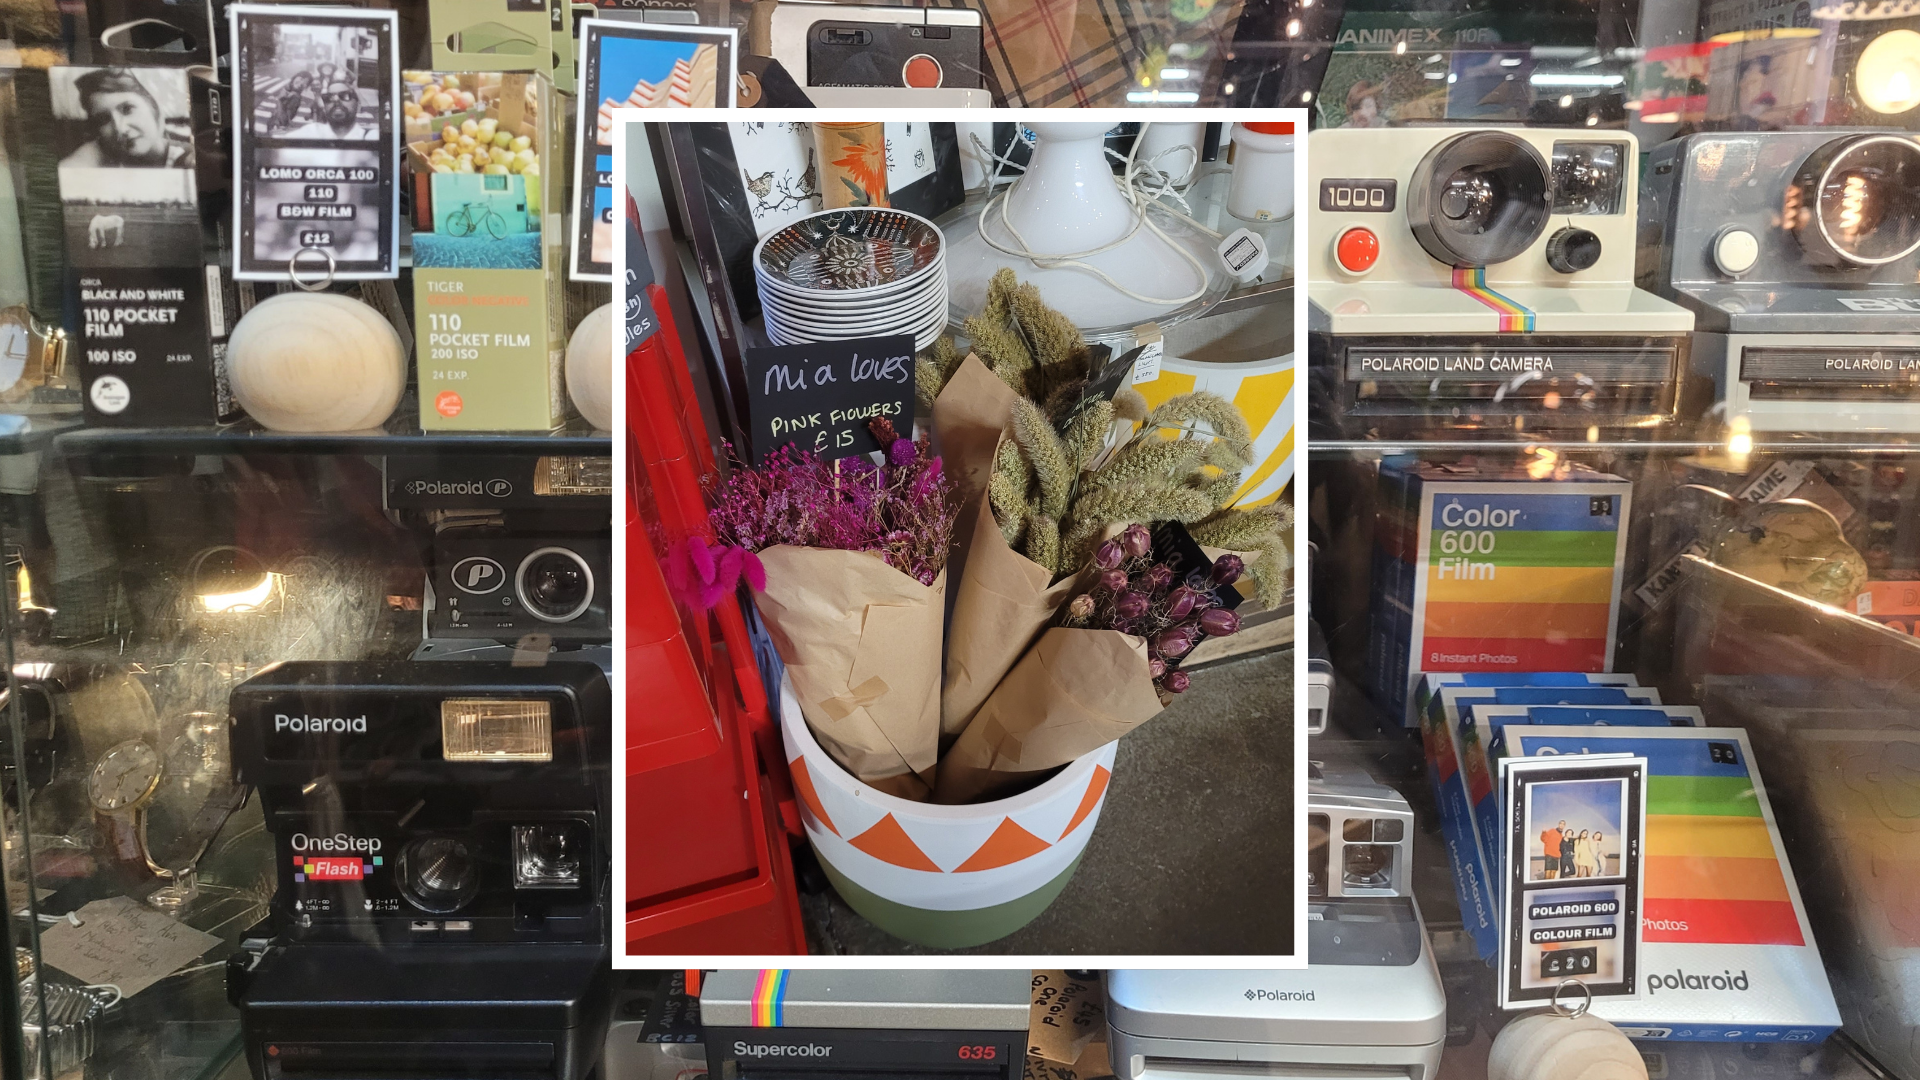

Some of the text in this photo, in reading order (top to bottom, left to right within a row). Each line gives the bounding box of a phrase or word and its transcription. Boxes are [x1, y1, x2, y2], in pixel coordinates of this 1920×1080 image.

[260, 167, 374, 180] LOMO ORCA 100
[308, 188, 334, 199] 110
[1329, 188, 1384, 206] 1000
[281, 206, 352, 218] B&W FILM
[304, 233, 330, 244] £12
[80, 279, 102, 287] ORCA
[427, 281, 464, 292] TIGER
[81, 290, 185, 300] BLACK AND WHITE
[84, 309, 178, 323] 110 POCKET
[429, 314, 462, 331] 110
[85, 323, 124, 337] FILM
[430, 334, 530, 347] POCKET FILM
[87, 351, 109, 363] 100
[112, 351, 137, 363] ISO
[431, 349, 478, 359] 200 ISO
[1362, 357, 1554, 372] POLAROID LAND CAMERA
[1825, 359, 1893, 370] POLAROID
[432, 371, 469, 380] 24 EXP.
[764, 353, 911, 395] Mia loves
[771, 412, 821, 437] PINK
[814, 430, 854, 453] £ 15
[415, 481, 483, 495] Polaroid
[1442, 503, 1521, 527] Color
[1440, 530, 1495, 554] 600
[1438, 557, 1495, 580] Film
[1431, 652, 1518, 664] 8 Instant Photos
[275, 714, 367, 733] Polaroid
[291, 833, 381, 855] OneStep
[315, 861, 358, 875] Flash
[1465, 862, 1488, 929] polaroid
[1532, 902, 1616, 917] POLAROID 600
[1533, 927, 1613, 941] COLOUR FILM
[1647, 969, 1749, 994] polaroid
[1034, 987, 1057, 1006] One
[1257, 989, 1315, 1001] Polaroid
[1042, 982, 1088, 1028] Polaroid
[733, 1041, 996, 1059] Supercolor 635
